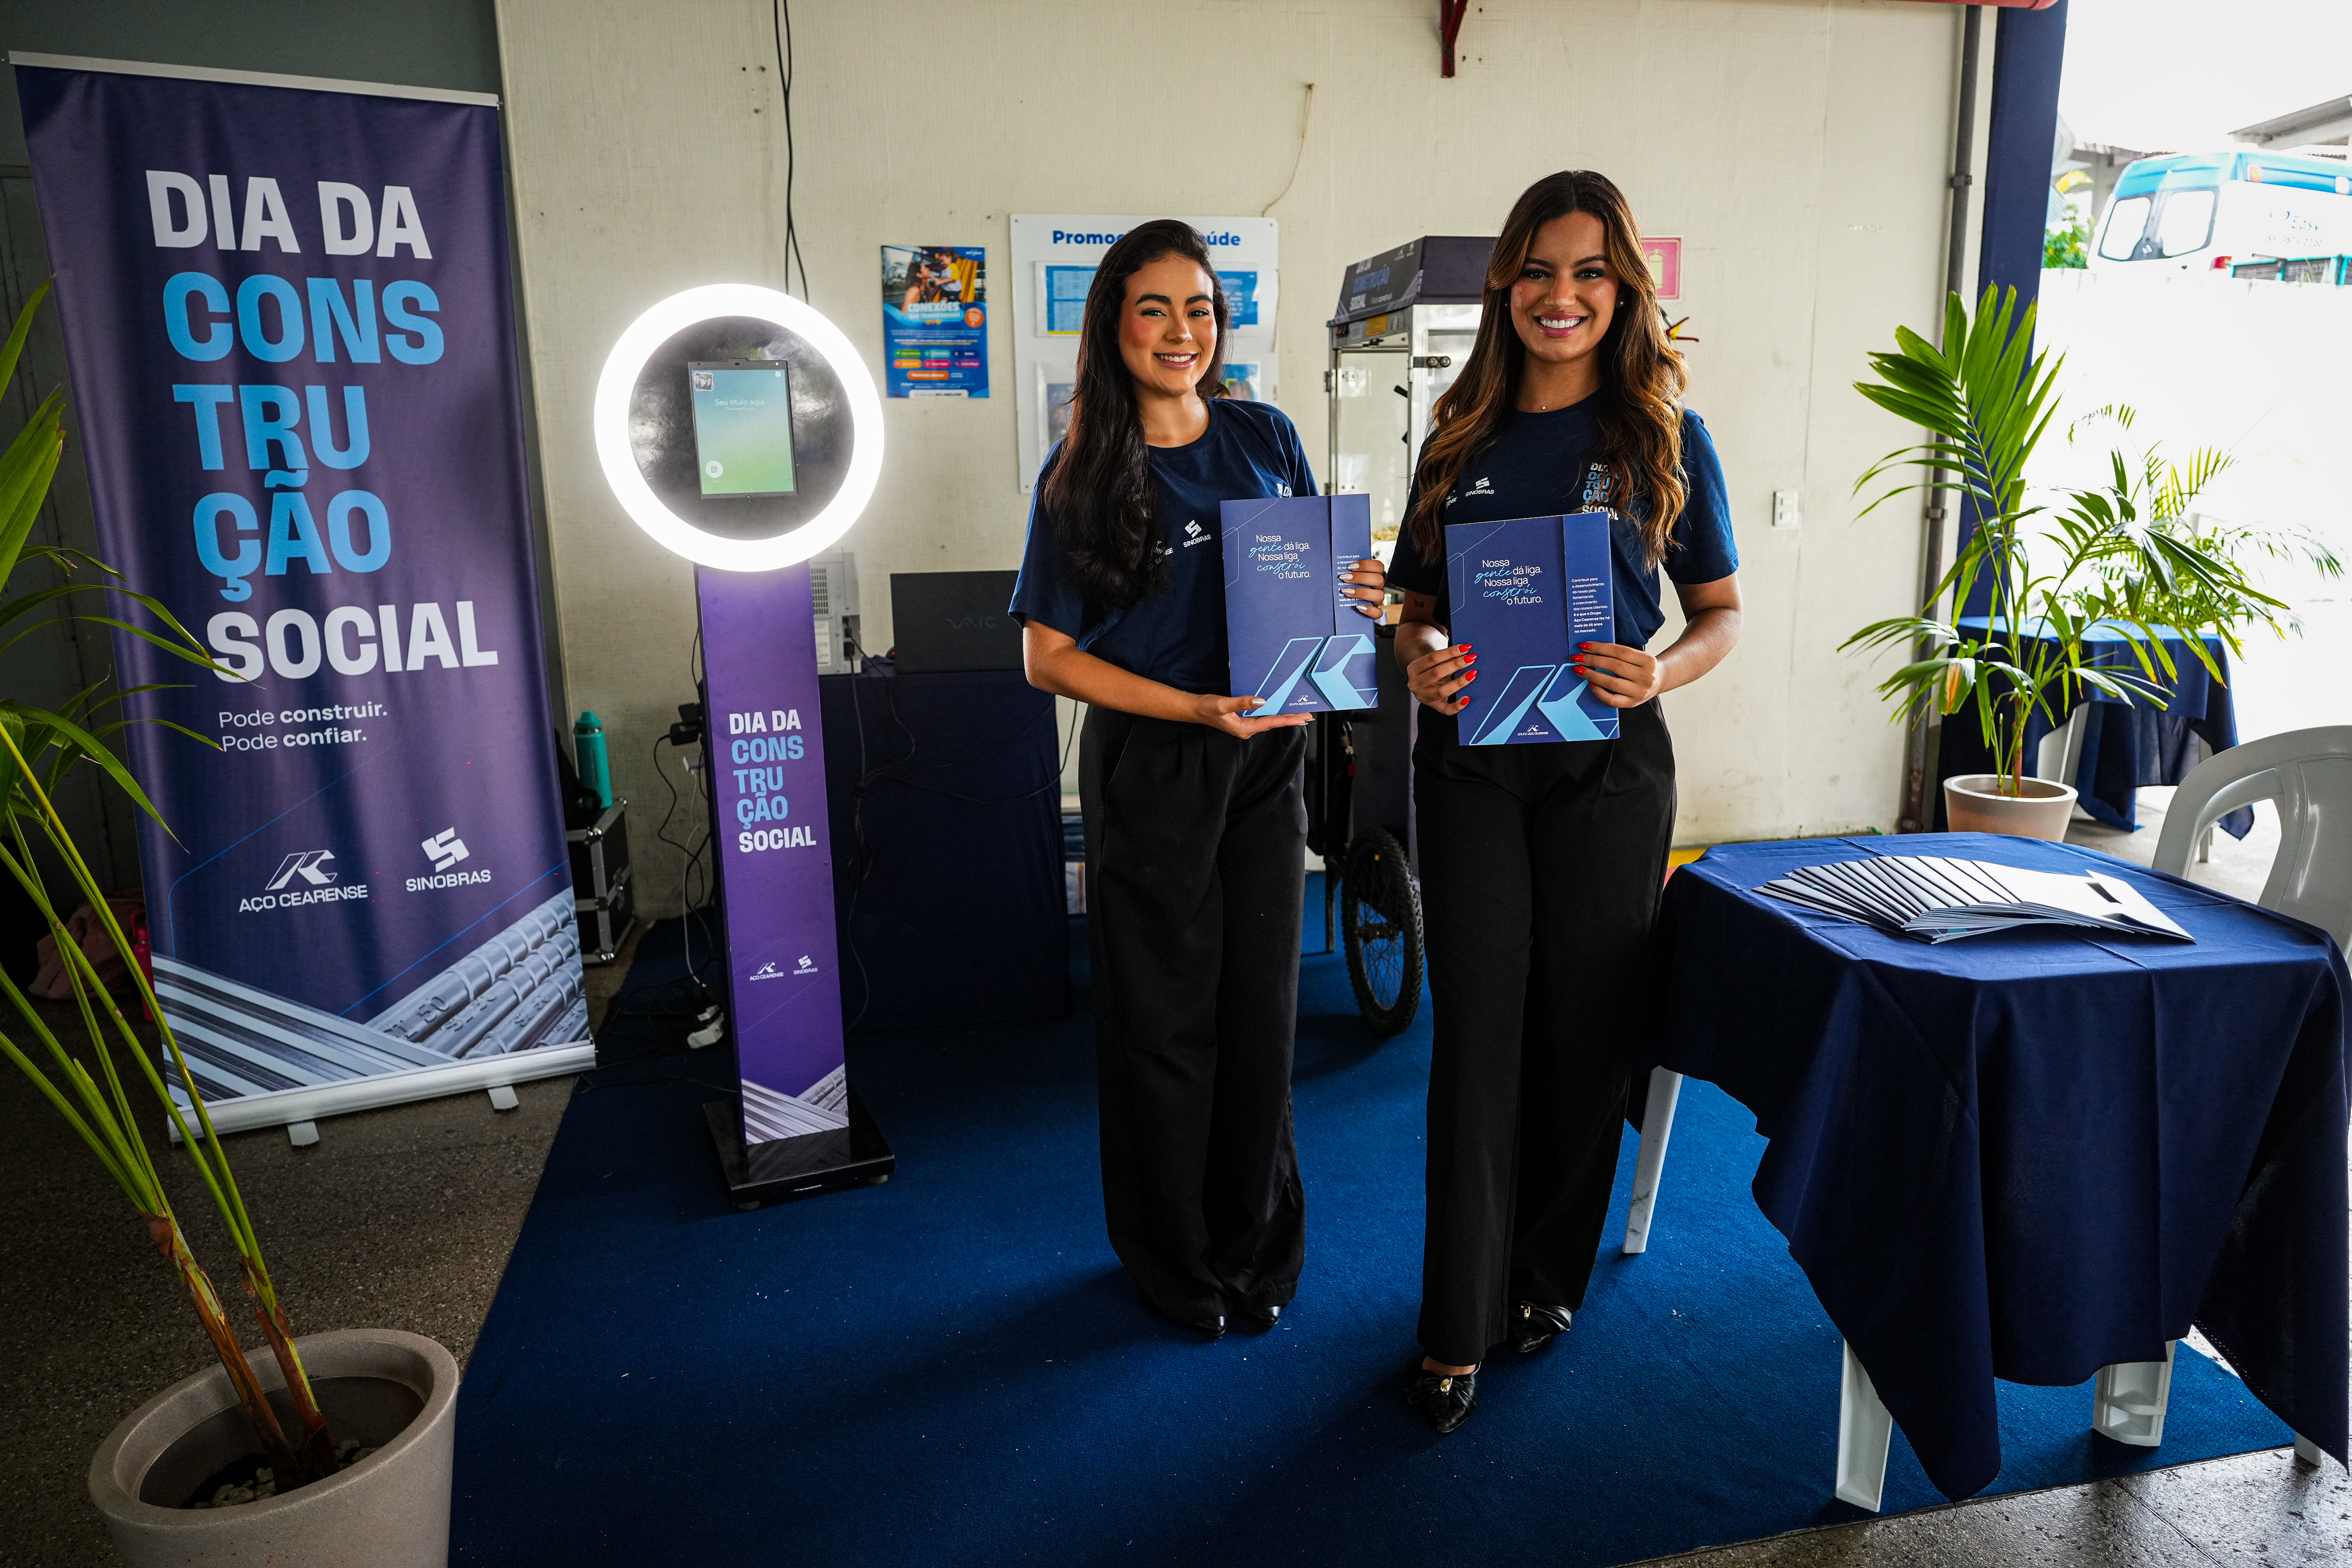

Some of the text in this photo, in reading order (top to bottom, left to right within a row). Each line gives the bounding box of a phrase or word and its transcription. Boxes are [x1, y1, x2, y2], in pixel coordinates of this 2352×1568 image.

[145, 170, 433, 260] DIA DA
[1052, 230, 1241, 246] Promo úde
[162, 271, 445, 366] CONS
[750, 398, 764, 407] aqui
[172, 384, 371, 470] TRU
[193, 469, 391, 602] ÇÃO
[1183, 534, 1211, 548] SINOBRAS
[1248, 541, 1311, 558] gente dá liga.
[1284, 552, 1298, 562] liga
[1257, 559, 1306, 574] constrói
[1474, 565, 1542, 584] gente dá liga.
[1482, 559, 1510, 568] Nossa
[1483, 584, 1537, 600] constrói
[1485, 577, 1528, 587] Nossa liga
[1514, 596, 1543, 605] futuro.
[206, 600, 499, 684] SOCIAL
[219, 701, 388, 728] Pode construir.
[729, 709, 802, 734] DIA DA
[222, 727, 367, 752] Pode confiar.
[731, 735, 804, 764] CONS
[733, 766, 784, 794] TRU
[737, 790, 788, 830] ÇÃO
[739, 826, 817, 853] SOCIAL
[405, 869, 492, 892] SINOBRAS
[239, 884, 368, 913] AÇO CEARENSE
